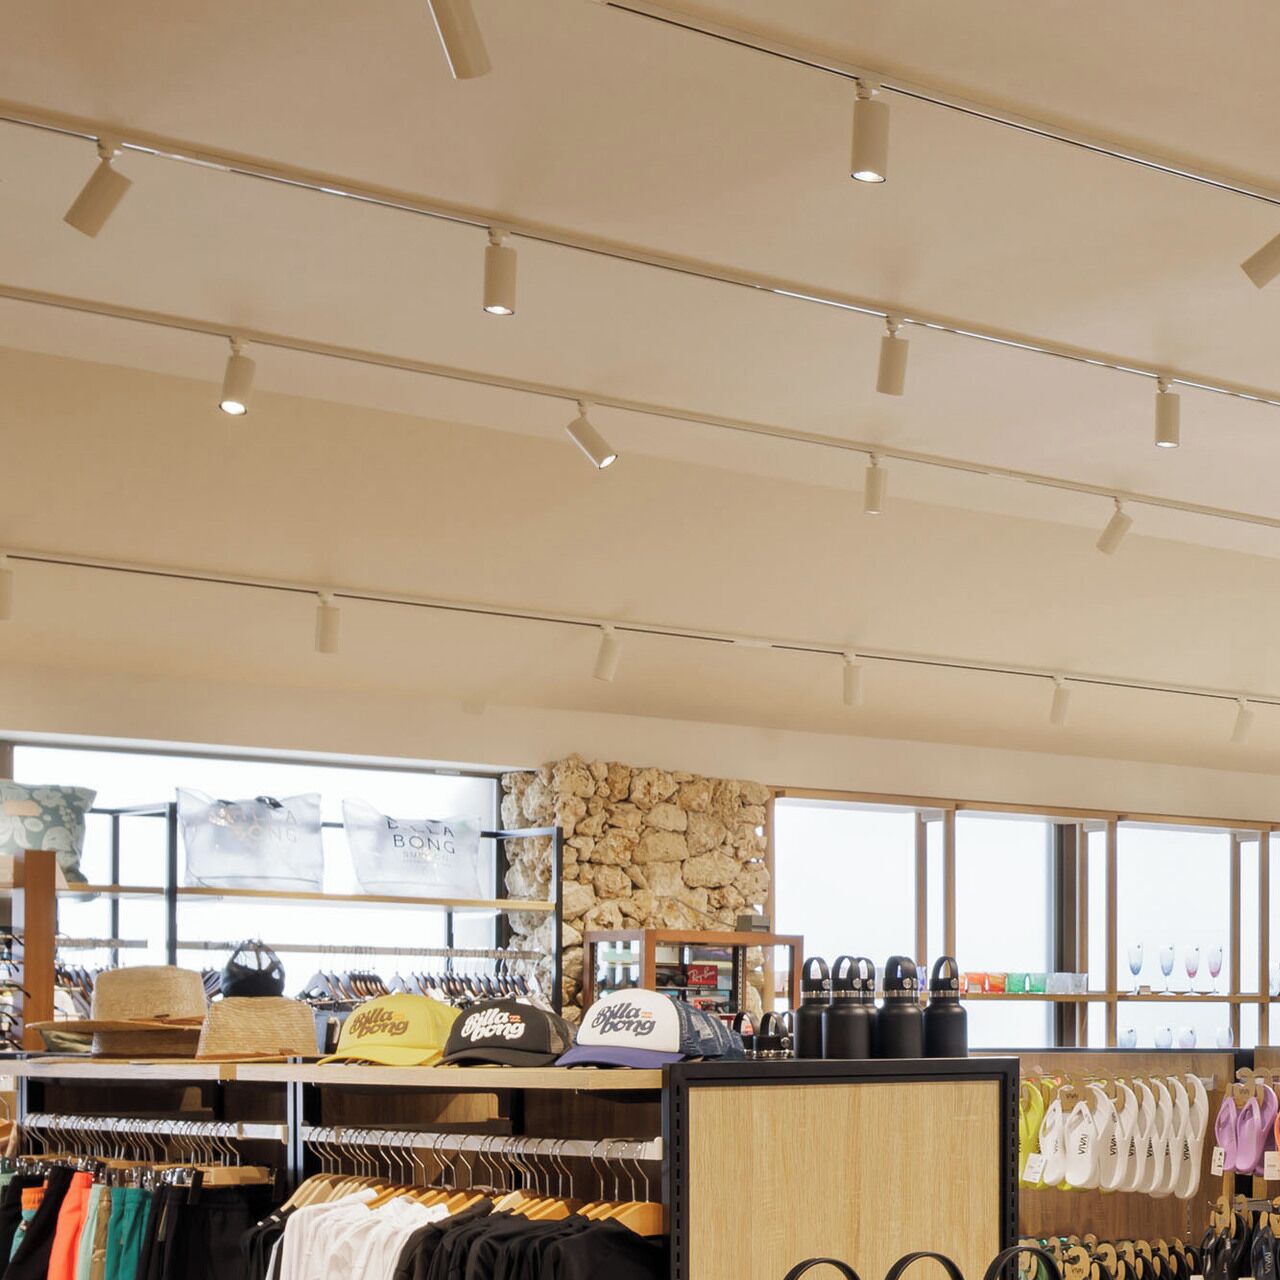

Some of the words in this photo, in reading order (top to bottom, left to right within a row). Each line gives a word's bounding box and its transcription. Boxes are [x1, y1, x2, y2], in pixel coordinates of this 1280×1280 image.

[393, 834, 456, 855] BONG
[350, 1007, 393, 1036] Billa
[357, 1018, 410, 1039] bong
[461, 1008, 509, 1039] Billa
[591, 1003, 642, 1036] Billa
[599, 1019, 656, 1036] bong
[470, 1021, 525, 1041] bong
